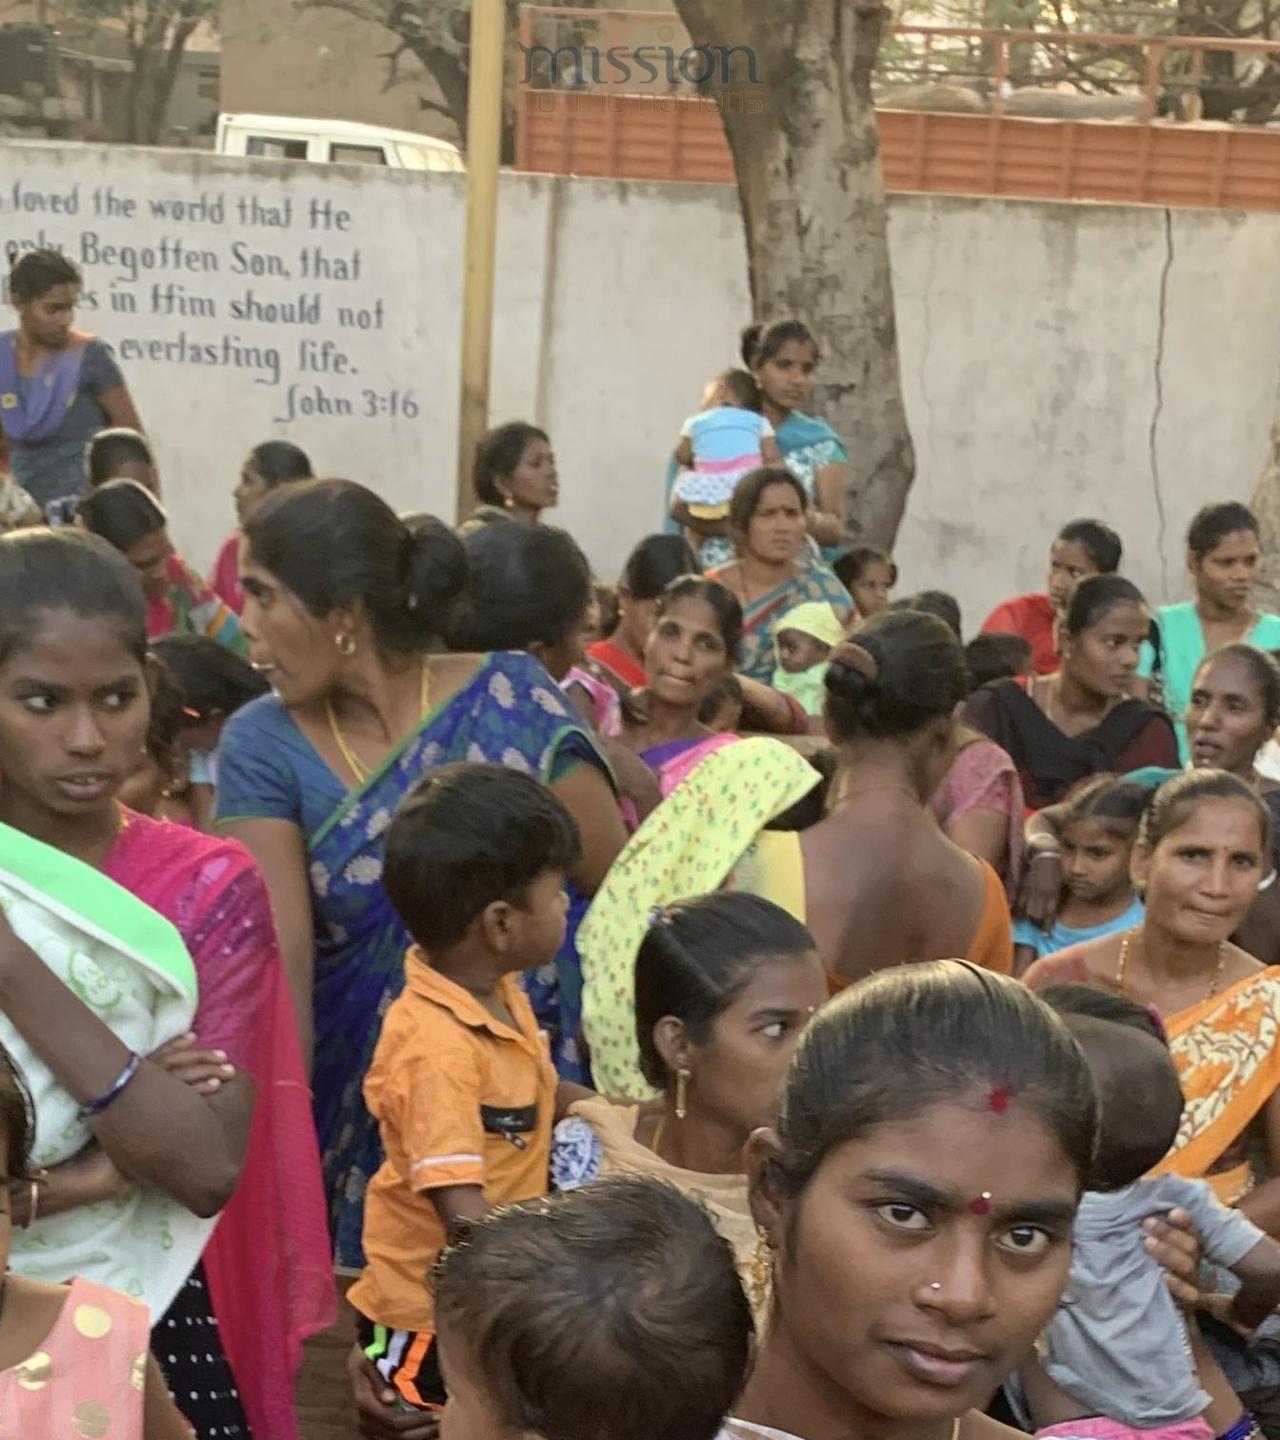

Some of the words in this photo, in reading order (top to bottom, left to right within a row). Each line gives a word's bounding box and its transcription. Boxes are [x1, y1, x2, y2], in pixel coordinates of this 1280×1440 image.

[13, 180, 79, 215] loved
[92, 185, 136, 219] the
[149, 192, 225, 225] world
[237, 195, 293, 228] that
[309, 197, 352, 232] He
[81, 231, 218, 282] Begotten
[230, 241, 291, 278] Son,
[300, 247, 361, 280] that
[110, 282, 136, 313] in
[151, 282, 216, 318] Him
[229, 289, 322, 326] should
[337, 299, 385, 330] not
[121, 331, 281, 385] everlasting
[298, 339, 359, 375] life.
[273, 384, 354, 424] John
[361, 389, 421, 419] 3:16
